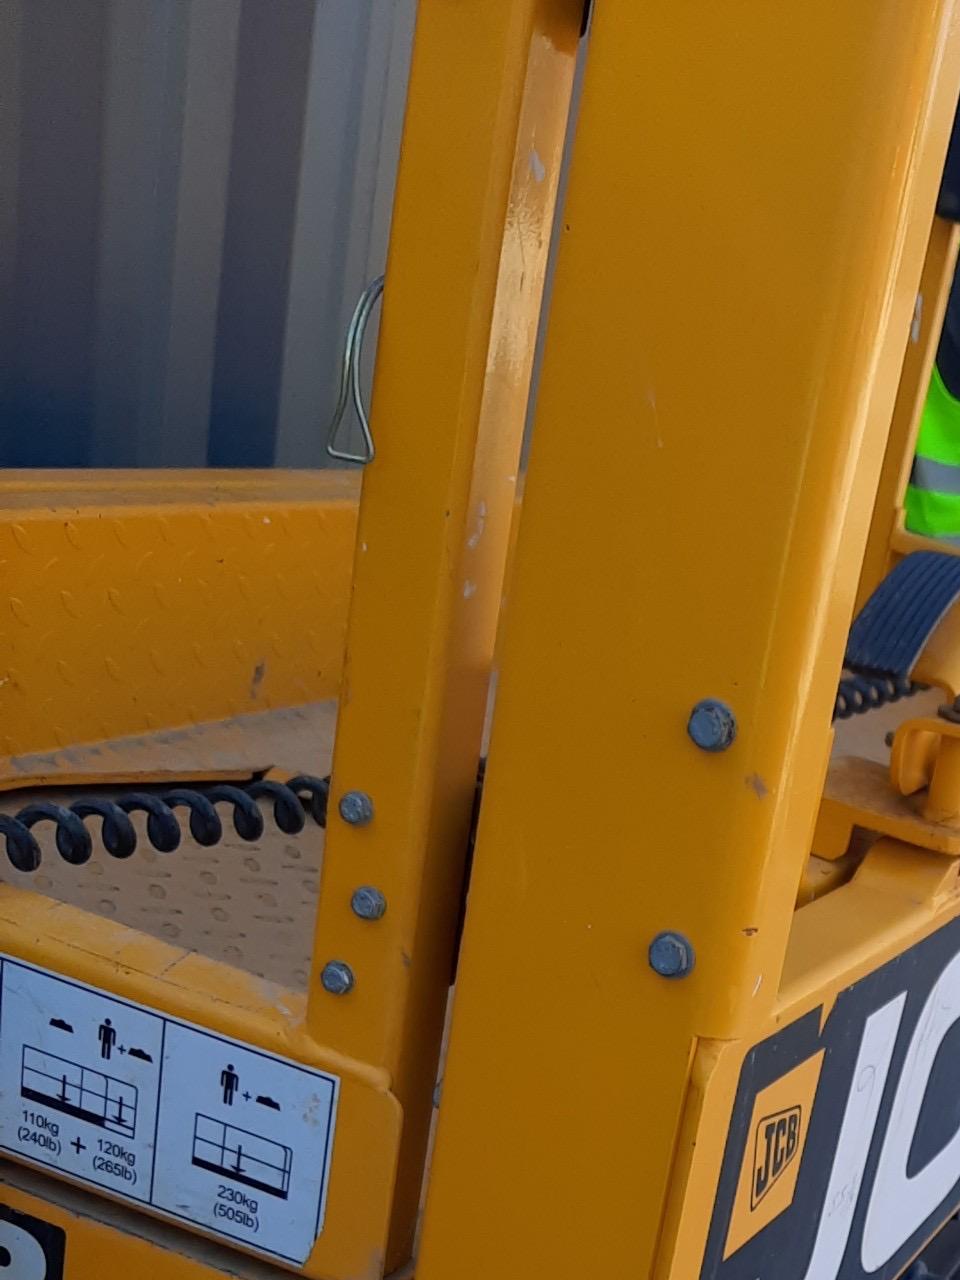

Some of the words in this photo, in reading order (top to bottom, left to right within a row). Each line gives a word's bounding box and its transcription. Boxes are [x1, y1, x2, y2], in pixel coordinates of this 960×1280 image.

[22, 1110, 60, 1137] 110kg
[17, 1126, 62, 1156] (240lb)
[97, 1139, 136, 1167] 120kg
[754, 1112, 799, 1199] JCB
[92, 1156, 138, 1185] (265lb)
[217, 1184, 258, 1214] 230kg
[213, 1203, 260, 1233] (505lb)
